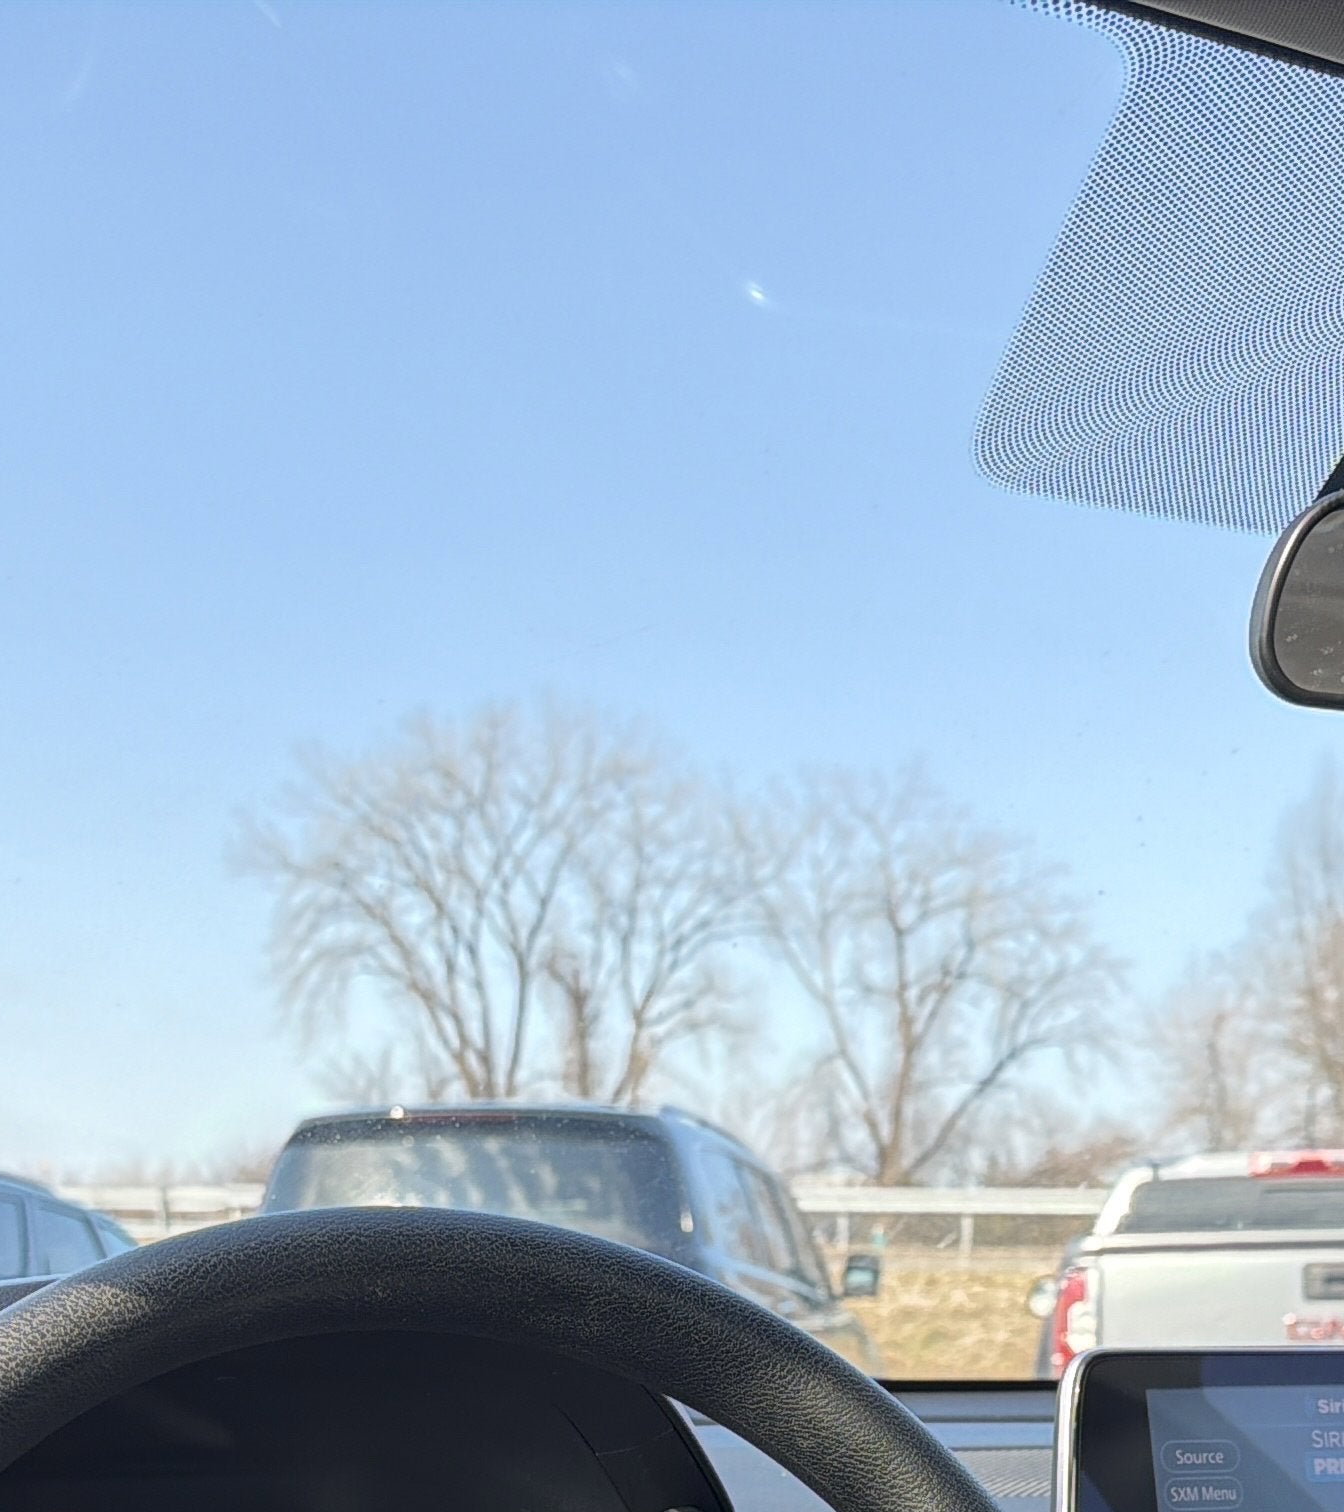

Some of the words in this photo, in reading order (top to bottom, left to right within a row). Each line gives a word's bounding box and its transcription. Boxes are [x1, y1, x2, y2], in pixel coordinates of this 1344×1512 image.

[1175, 1449, 1224, 1465] Source
[1170, 1487, 1199, 1502] SXM
[1202, 1486, 1236, 1500] Menu
